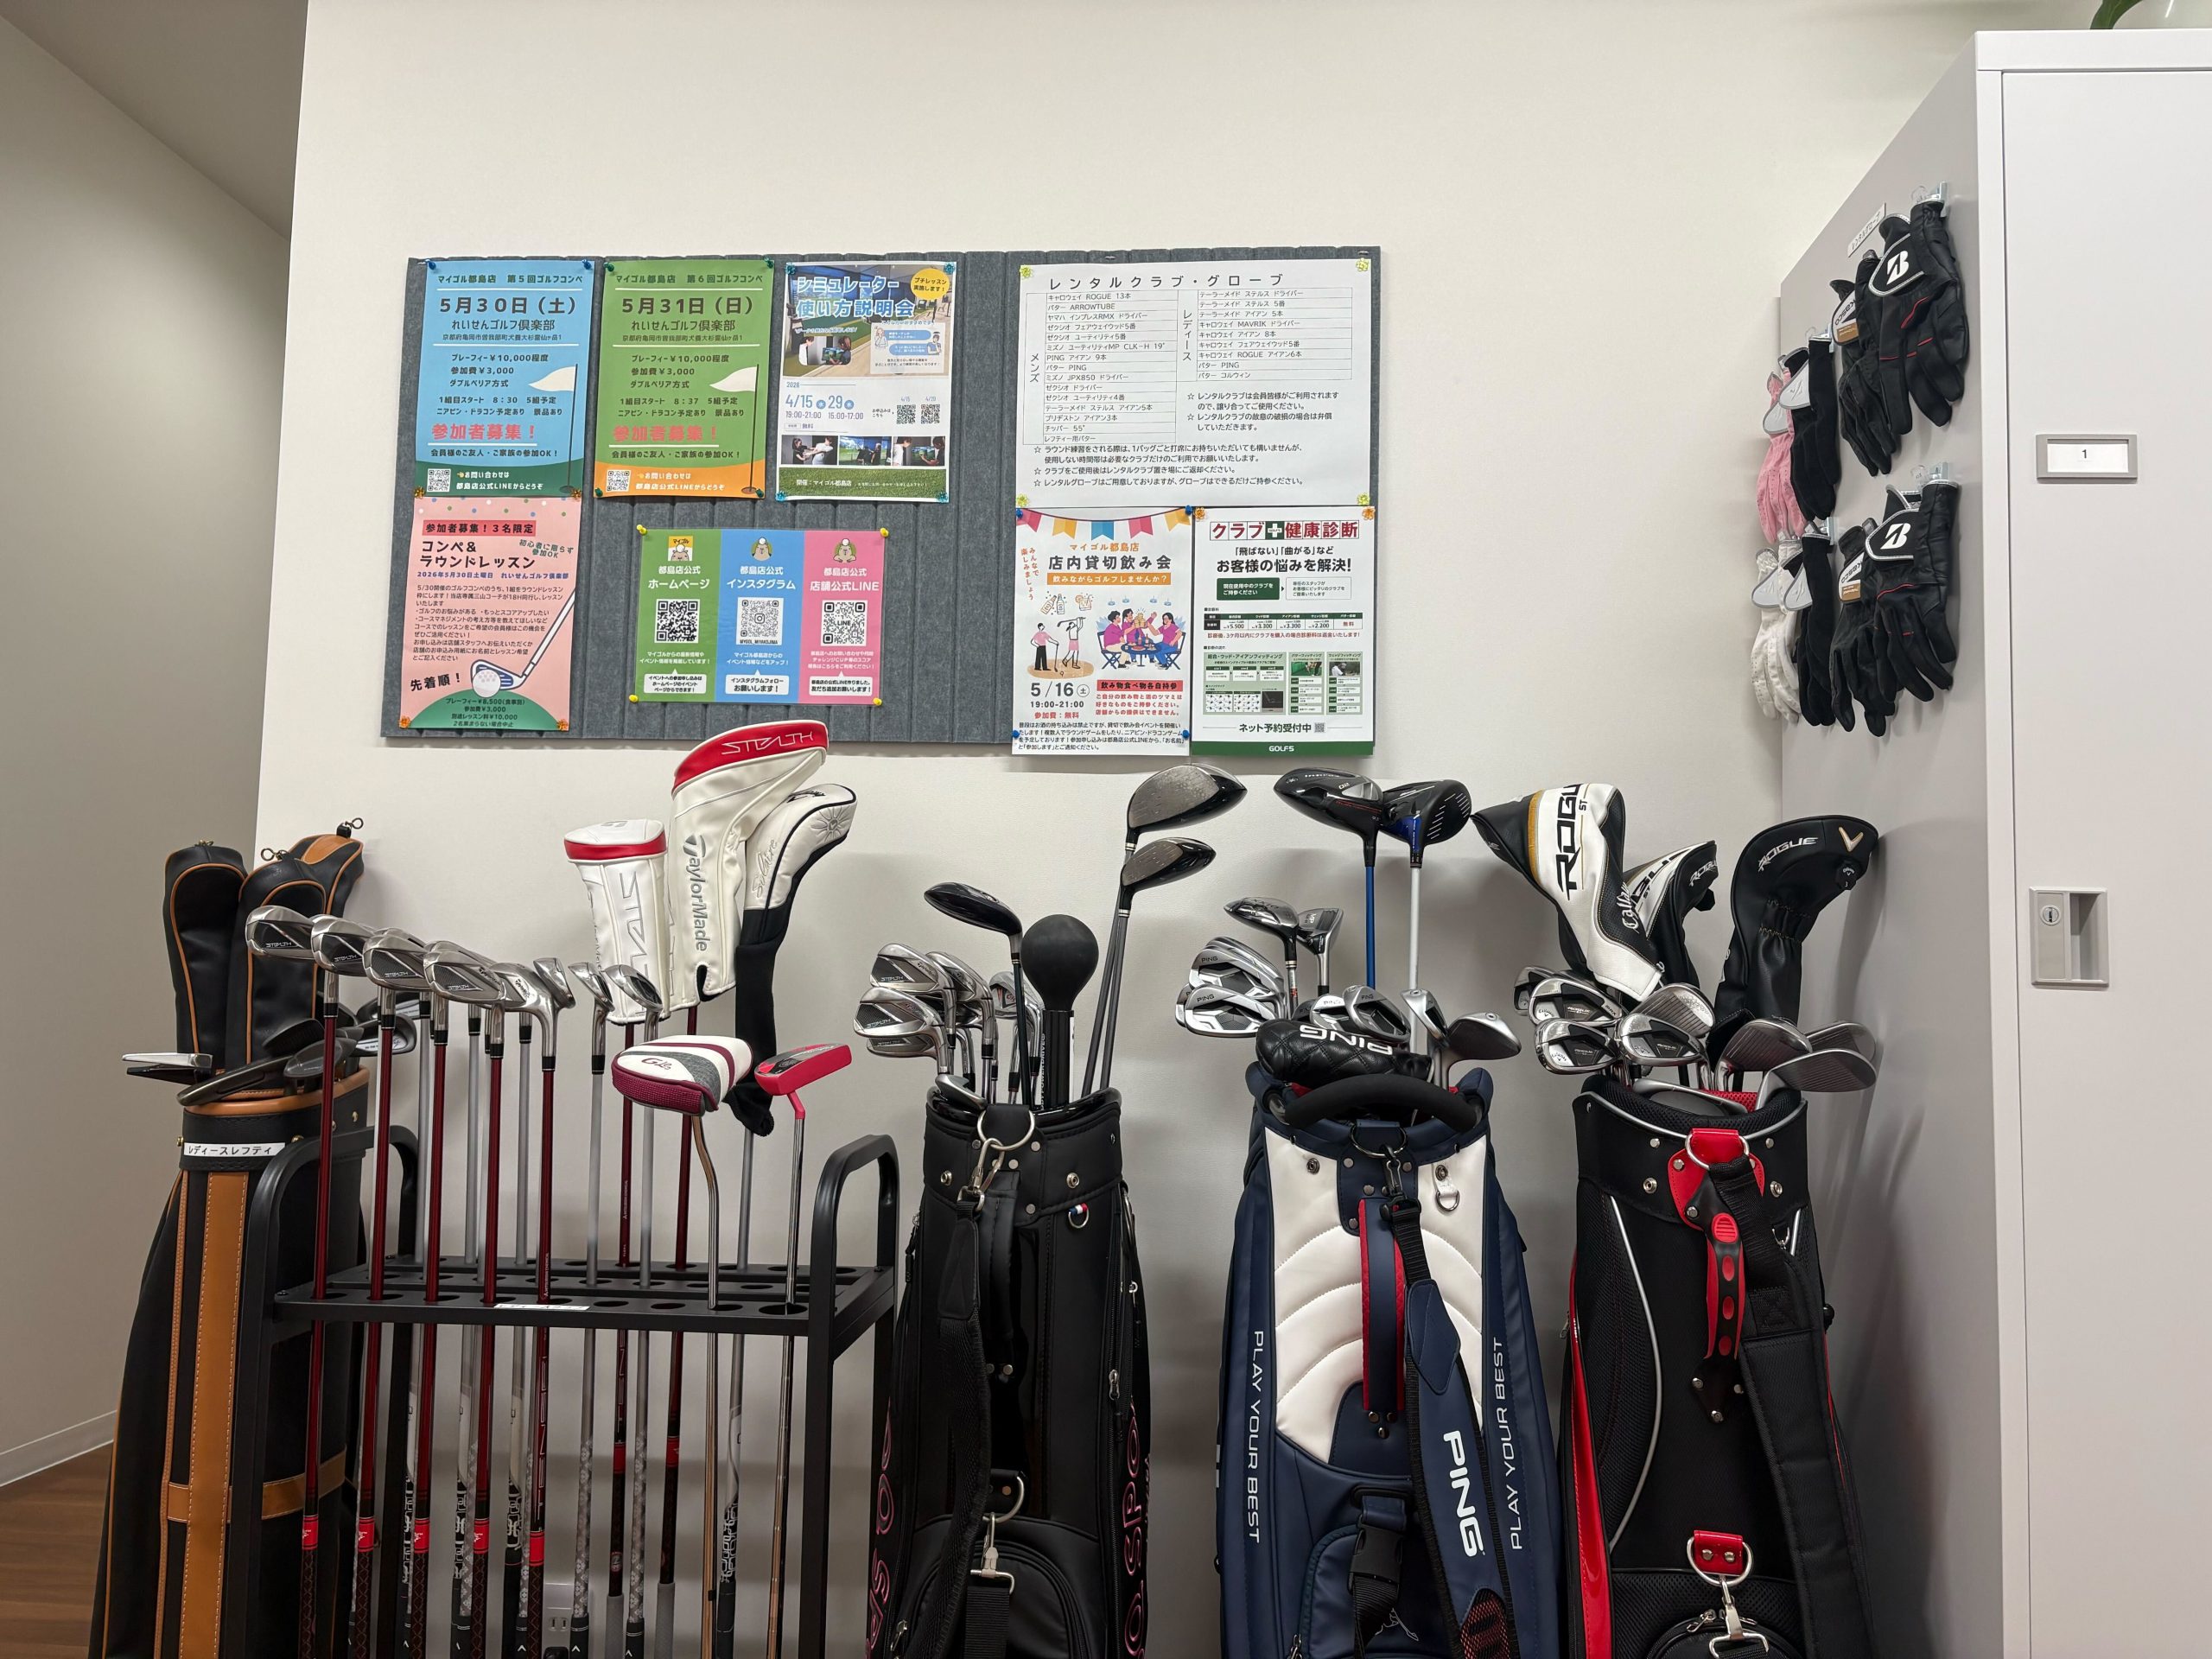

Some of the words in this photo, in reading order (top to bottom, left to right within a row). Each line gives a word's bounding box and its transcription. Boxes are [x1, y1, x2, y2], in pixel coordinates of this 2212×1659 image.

[437, 275, 496, 283] マイゴル都島店
[616, 275, 676, 283] マイゴル都島店
[797, 276, 899, 294] シミュレーター
[796, 299, 916, 318] 使い方説明会
[451, 320, 555, 331] れいせんゴルフ倶楽部
[631, 320, 735, 331] れいせんゴルフ倶楽部
[1183, 309, 1192, 361] レディース
[1030, 353, 1039, 383] メンズ
[631, 380, 690, 389] ダブルペリア方式
[2082, 449, 2088, 459] 1
[1212, 522, 1265, 539] クラブ
[1285, 522, 1358, 538] 健康診断
[1070, 543, 1140, 552] マイゴル都島店
[420, 556, 535, 569] ラウンドレッスン
[1029, 548, 1039, 576] みんなで
[1049, 555, 1171, 570] 店内貸切飲み会
[658, 565, 701, 575] 都島店公式
[740, 566, 783, 575] 都島店公式
[823, 568, 867, 576] 都島店公式
[1020, 548, 1033, 600] 楽しみましょう
[648, 579, 709, 589] ホームページ
[727, 580, 796, 589] インスタグラム
[810, 581, 880, 591] 店舗公式LINE
[1239, 723, 1312, 733] ネット予約受付中
[1555, 783, 1580, 900] ROGU
[1197, 994, 1214, 1002] PING
[1300, 1025, 1393, 1055] PING
[188, 1145, 272, 1155] レディースレフティ
[1252, 1331, 1264, 1394] PLAY
[1492, 1336, 1505, 1400] BEST
[1246, 1398, 1262, 1471] YOUR
[1497, 1407, 1516, 1478] YOUR
[1443, 1430, 1484, 1558] PING
[1246, 1476, 1261, 1543] BEST
[1505, 1483, 1523, 1550] PLAY
